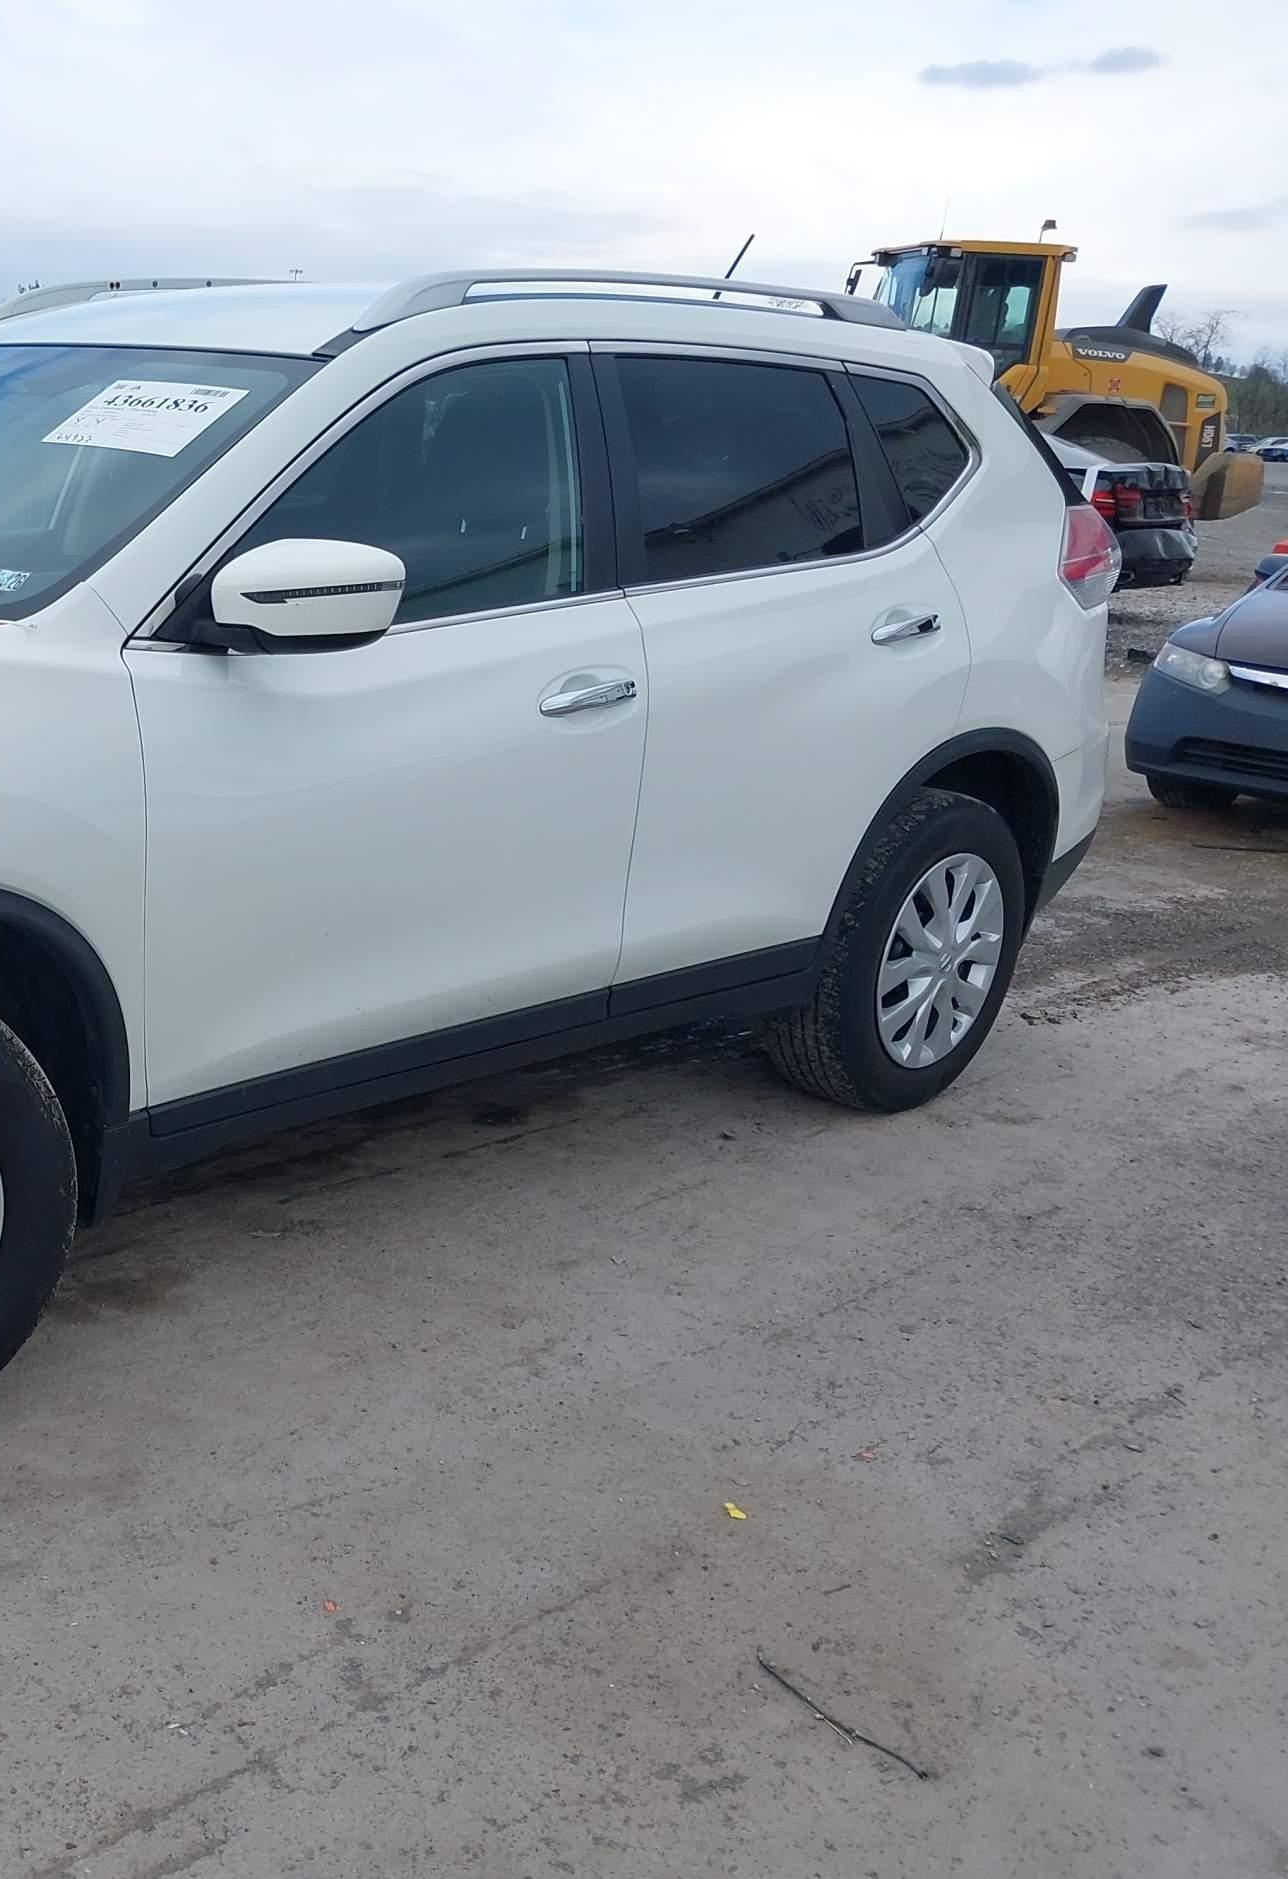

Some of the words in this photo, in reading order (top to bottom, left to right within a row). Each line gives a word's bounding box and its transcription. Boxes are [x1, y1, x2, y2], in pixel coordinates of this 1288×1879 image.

[1076, 348, 1125, 360] VOLVO
[103, 393, 216, 415] 43661836
[1201, 425, 1216, 448] L90H
